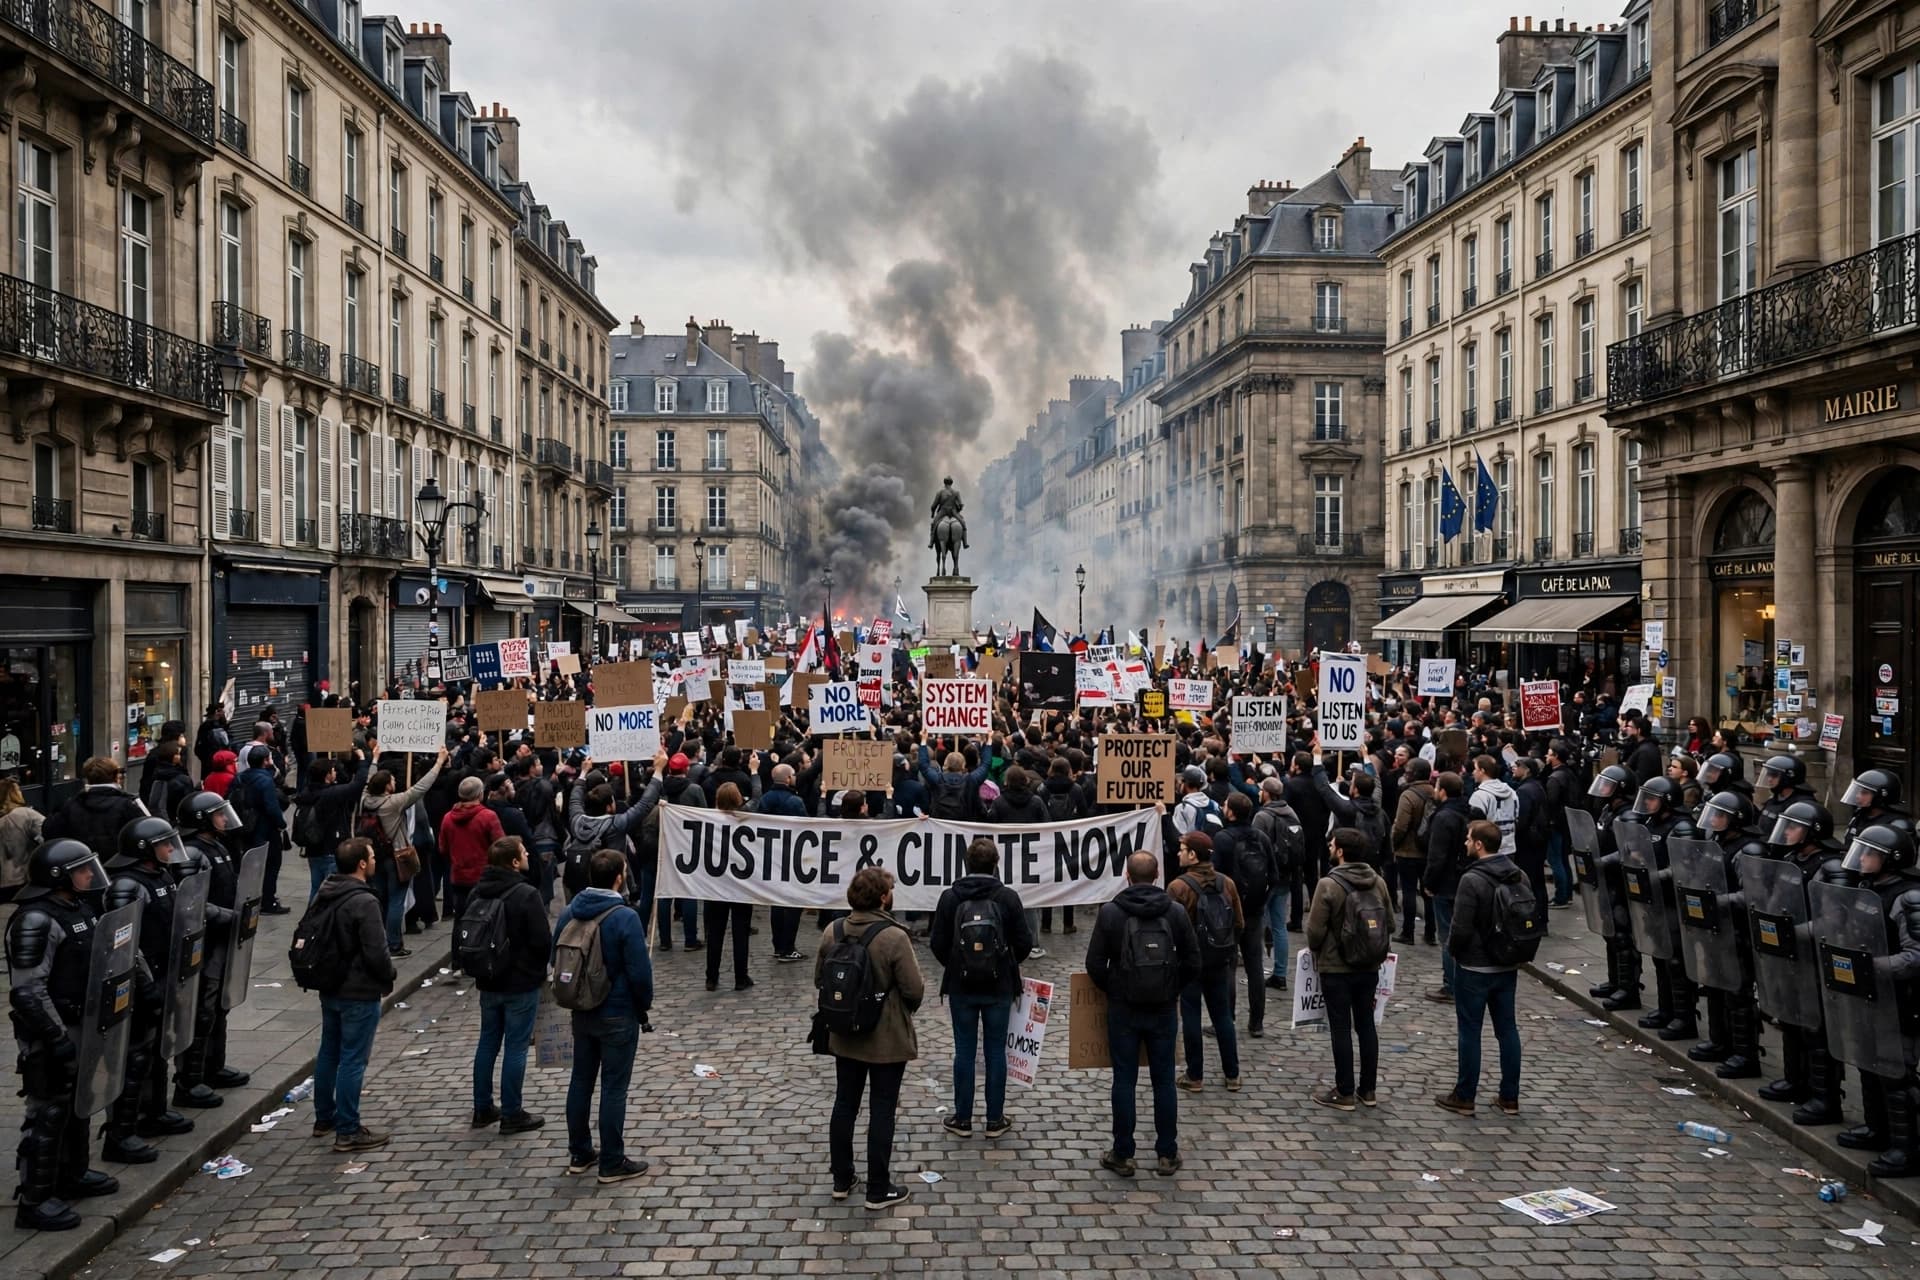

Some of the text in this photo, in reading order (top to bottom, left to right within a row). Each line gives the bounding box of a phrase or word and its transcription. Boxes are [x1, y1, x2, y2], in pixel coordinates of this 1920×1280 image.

[1824, 384, 1899, 422] MAIRIE
[1541, 575, 1611, 592] CAFÉ DE LA PAIX
[1329, 667, 1355, 692] NO
[825, 686, 850, 704] NO
[926, 683, 987, 704] SYSTEM
[820, 703, 867, 724] MORE
[926, 706, 988, 727] CHANGE
[1237, 701, 1282, 717] LISTEN
[1322, 702, 1363, 720] LISTEN
[595, 712, 613, 732] NO
[618, 710, 653, 730] MORE
[1322, 723, 1357, 740] TO US
[832, 741, 887, 758] PROTECT
[1104, 739, 1171, 758] PROTECT
[1121, 760, 1151, 778] OUR
[832, 772, 885, 787] FUTURE
[1106, 781, 1165, 799] FUTURE
[675, 820, 842, 884] JUSTICE
[856, 834, 884, 873] &
[1054, 822, 1147, 882] NOW
[1014, 1036, 1040, 1057] MORE
